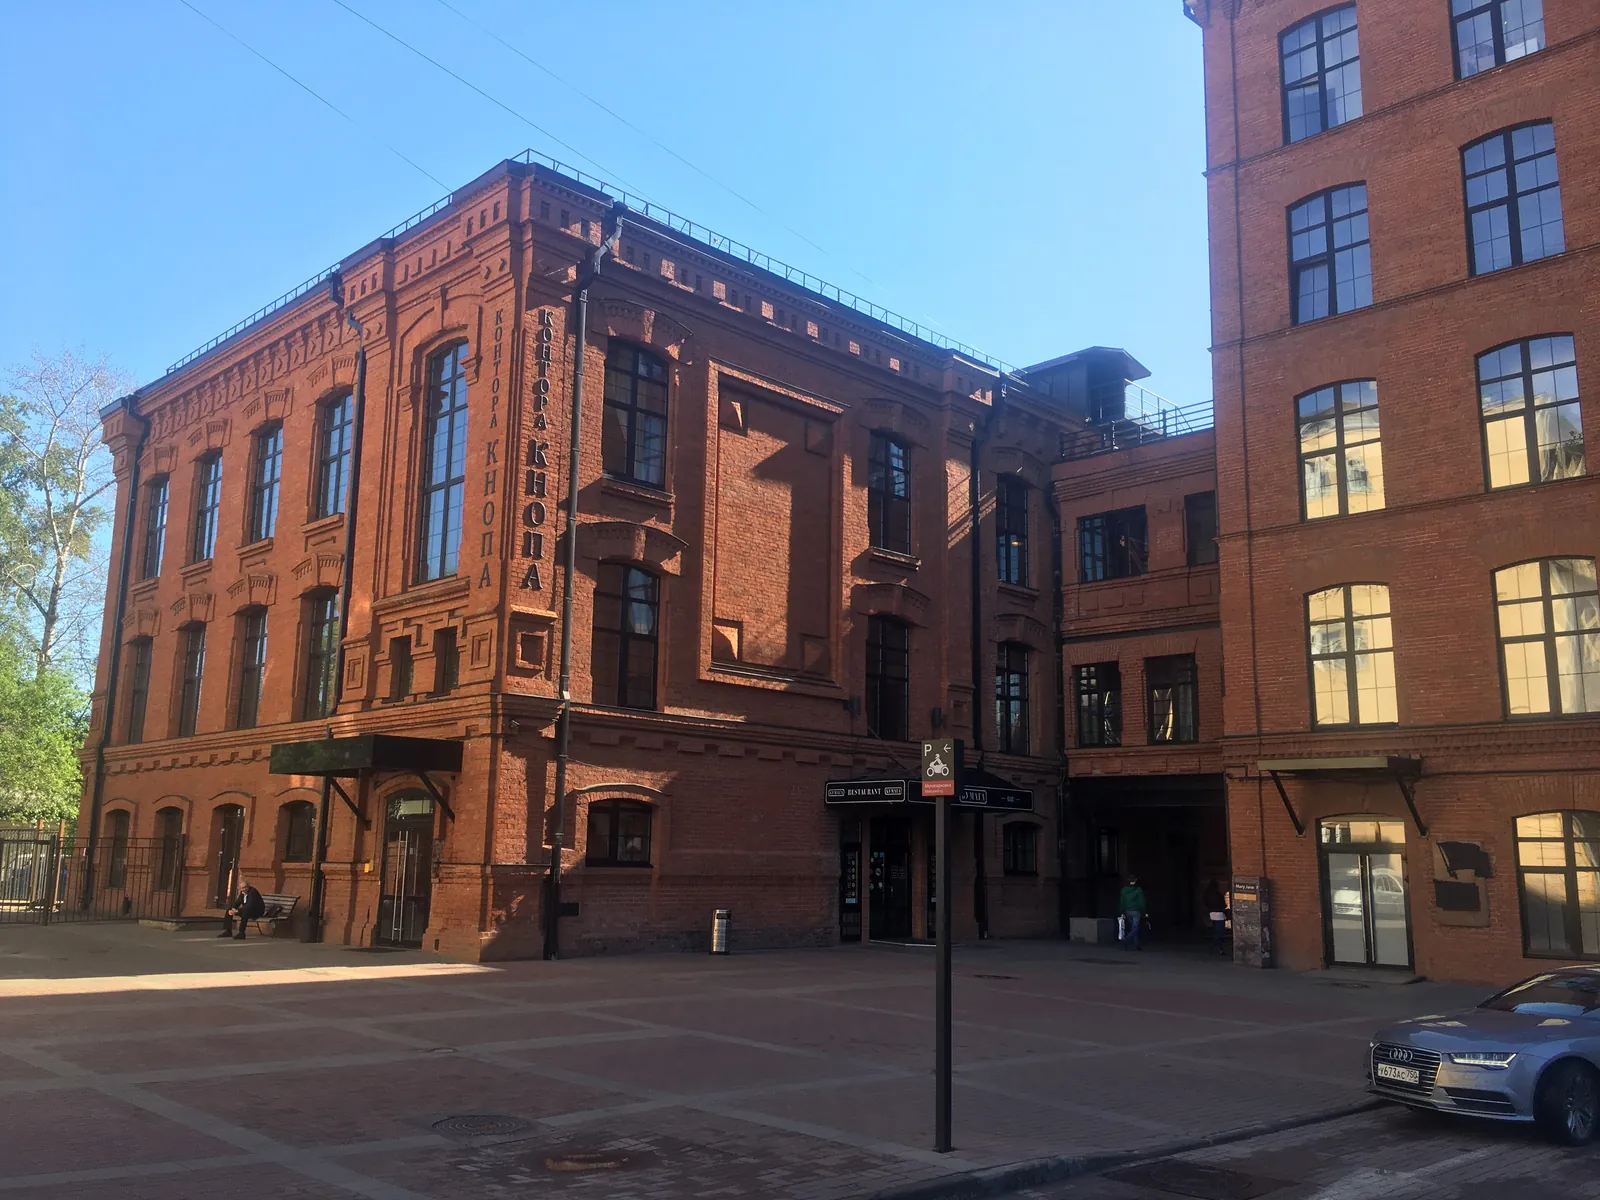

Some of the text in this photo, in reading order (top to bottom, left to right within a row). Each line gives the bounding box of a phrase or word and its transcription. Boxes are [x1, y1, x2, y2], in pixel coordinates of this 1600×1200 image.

[478, 308, 503, 589] КОНТОРА КНОПА
[526, 309, 554, 590] КОНТОРА КНОПА
[847, 788, 881, 796] RESTAURANT
[924, 744, 932, 757] P
